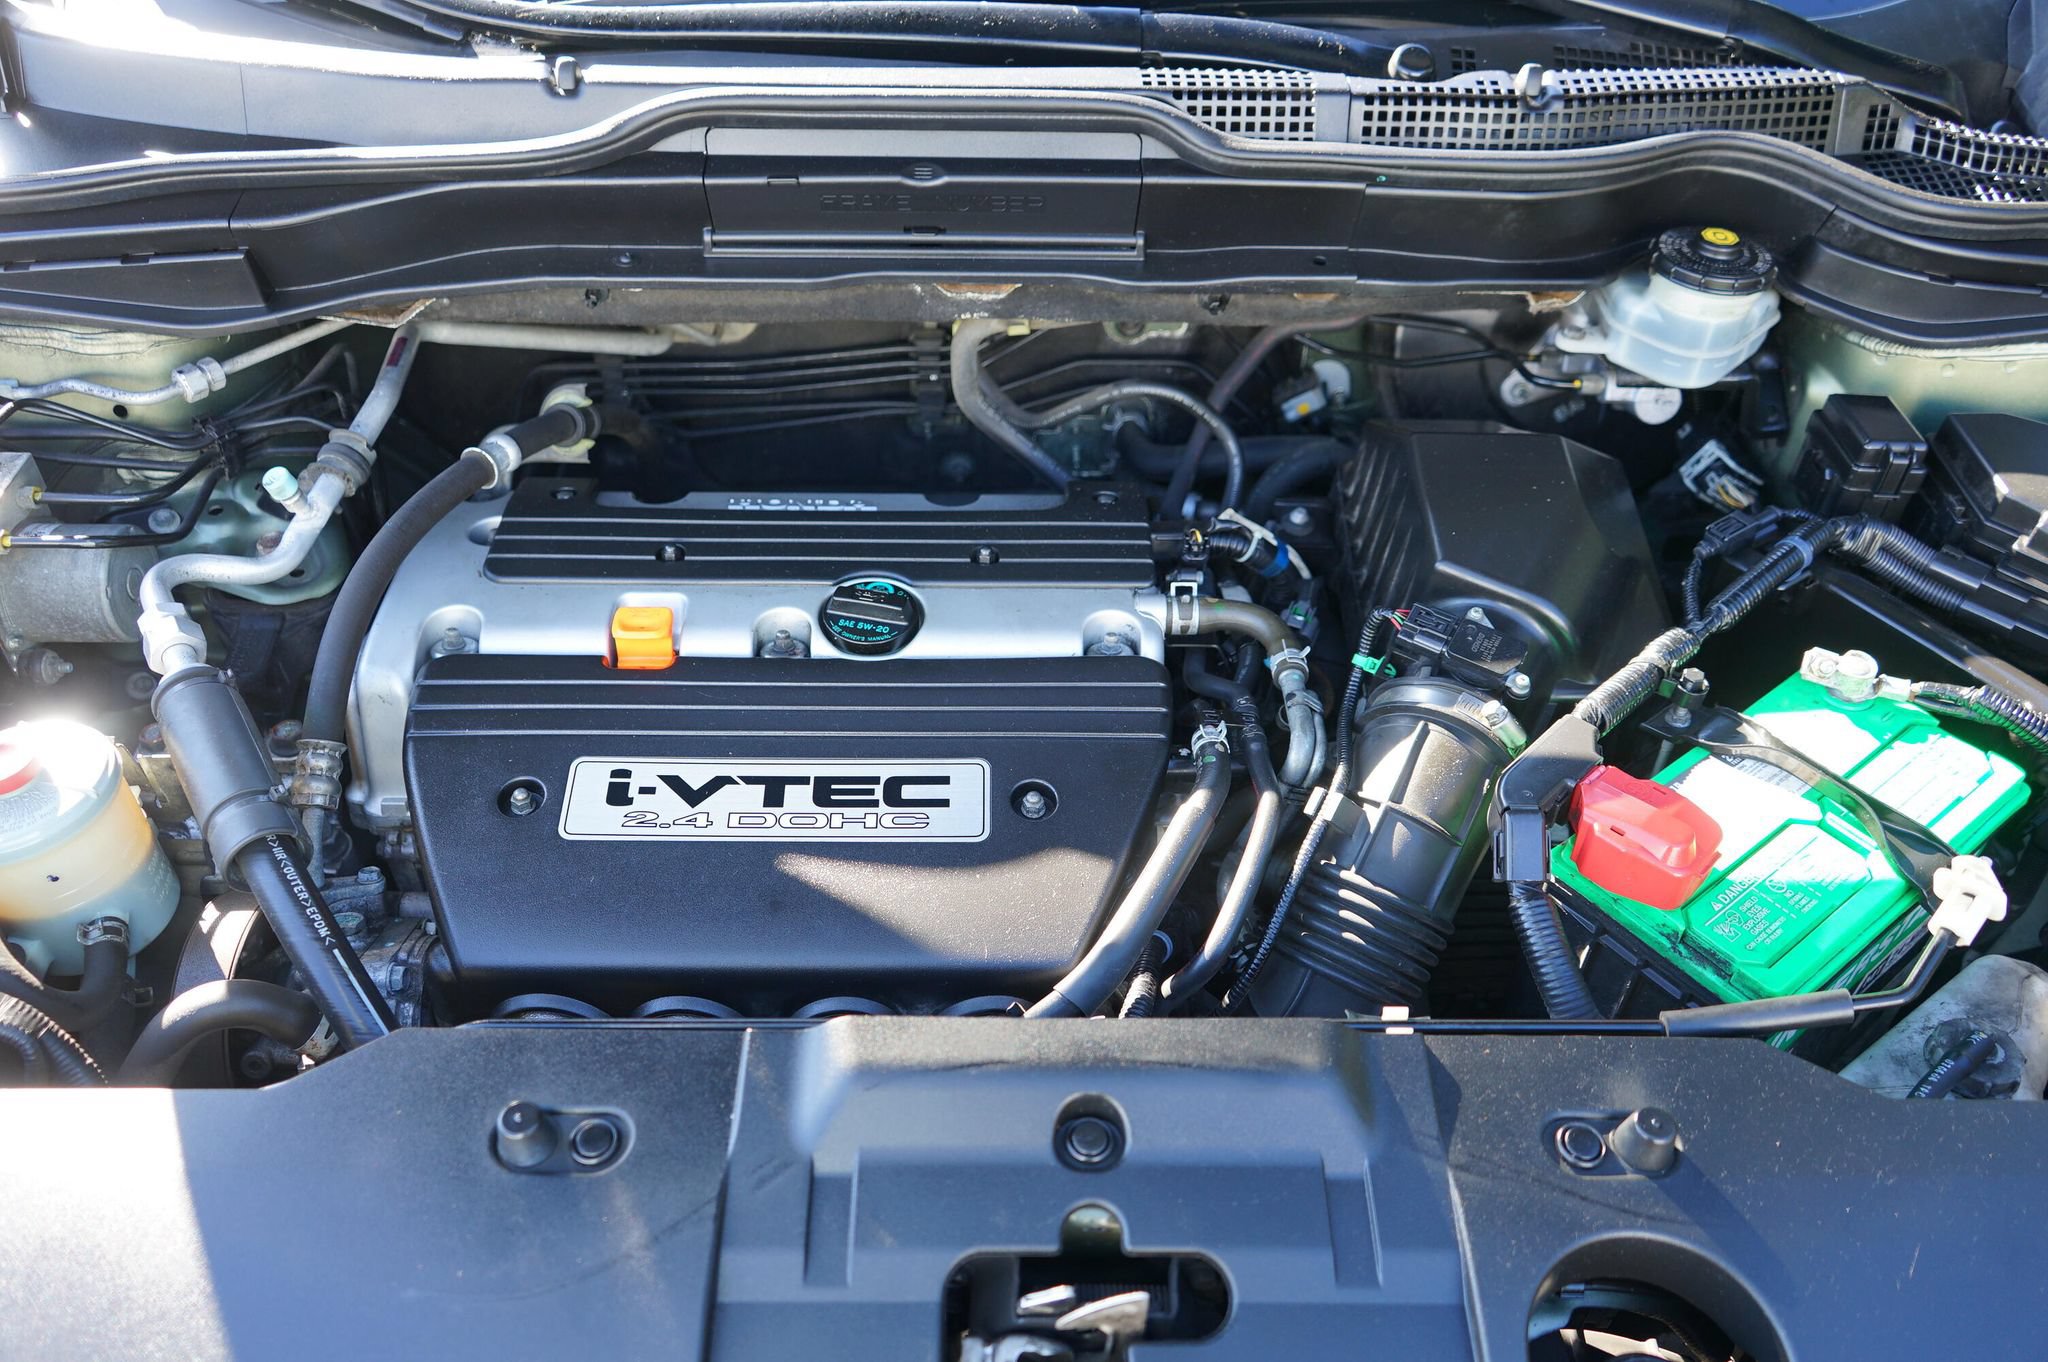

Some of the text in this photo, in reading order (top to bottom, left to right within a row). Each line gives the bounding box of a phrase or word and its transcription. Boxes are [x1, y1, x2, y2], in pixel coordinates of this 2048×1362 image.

[839, 618, 856, 628] SAE
[605, 768, 951, 809] i-VTEC
[621, 810, 931, 830] 2.4 DOHC
[1739, 895, 1758, 911] SHIELD
[1745, 904, 1762, 918] EYES
[1742, 906, 1771, 931] EXPLOSIVE
[1750, 918, 1769, 936] GASES
